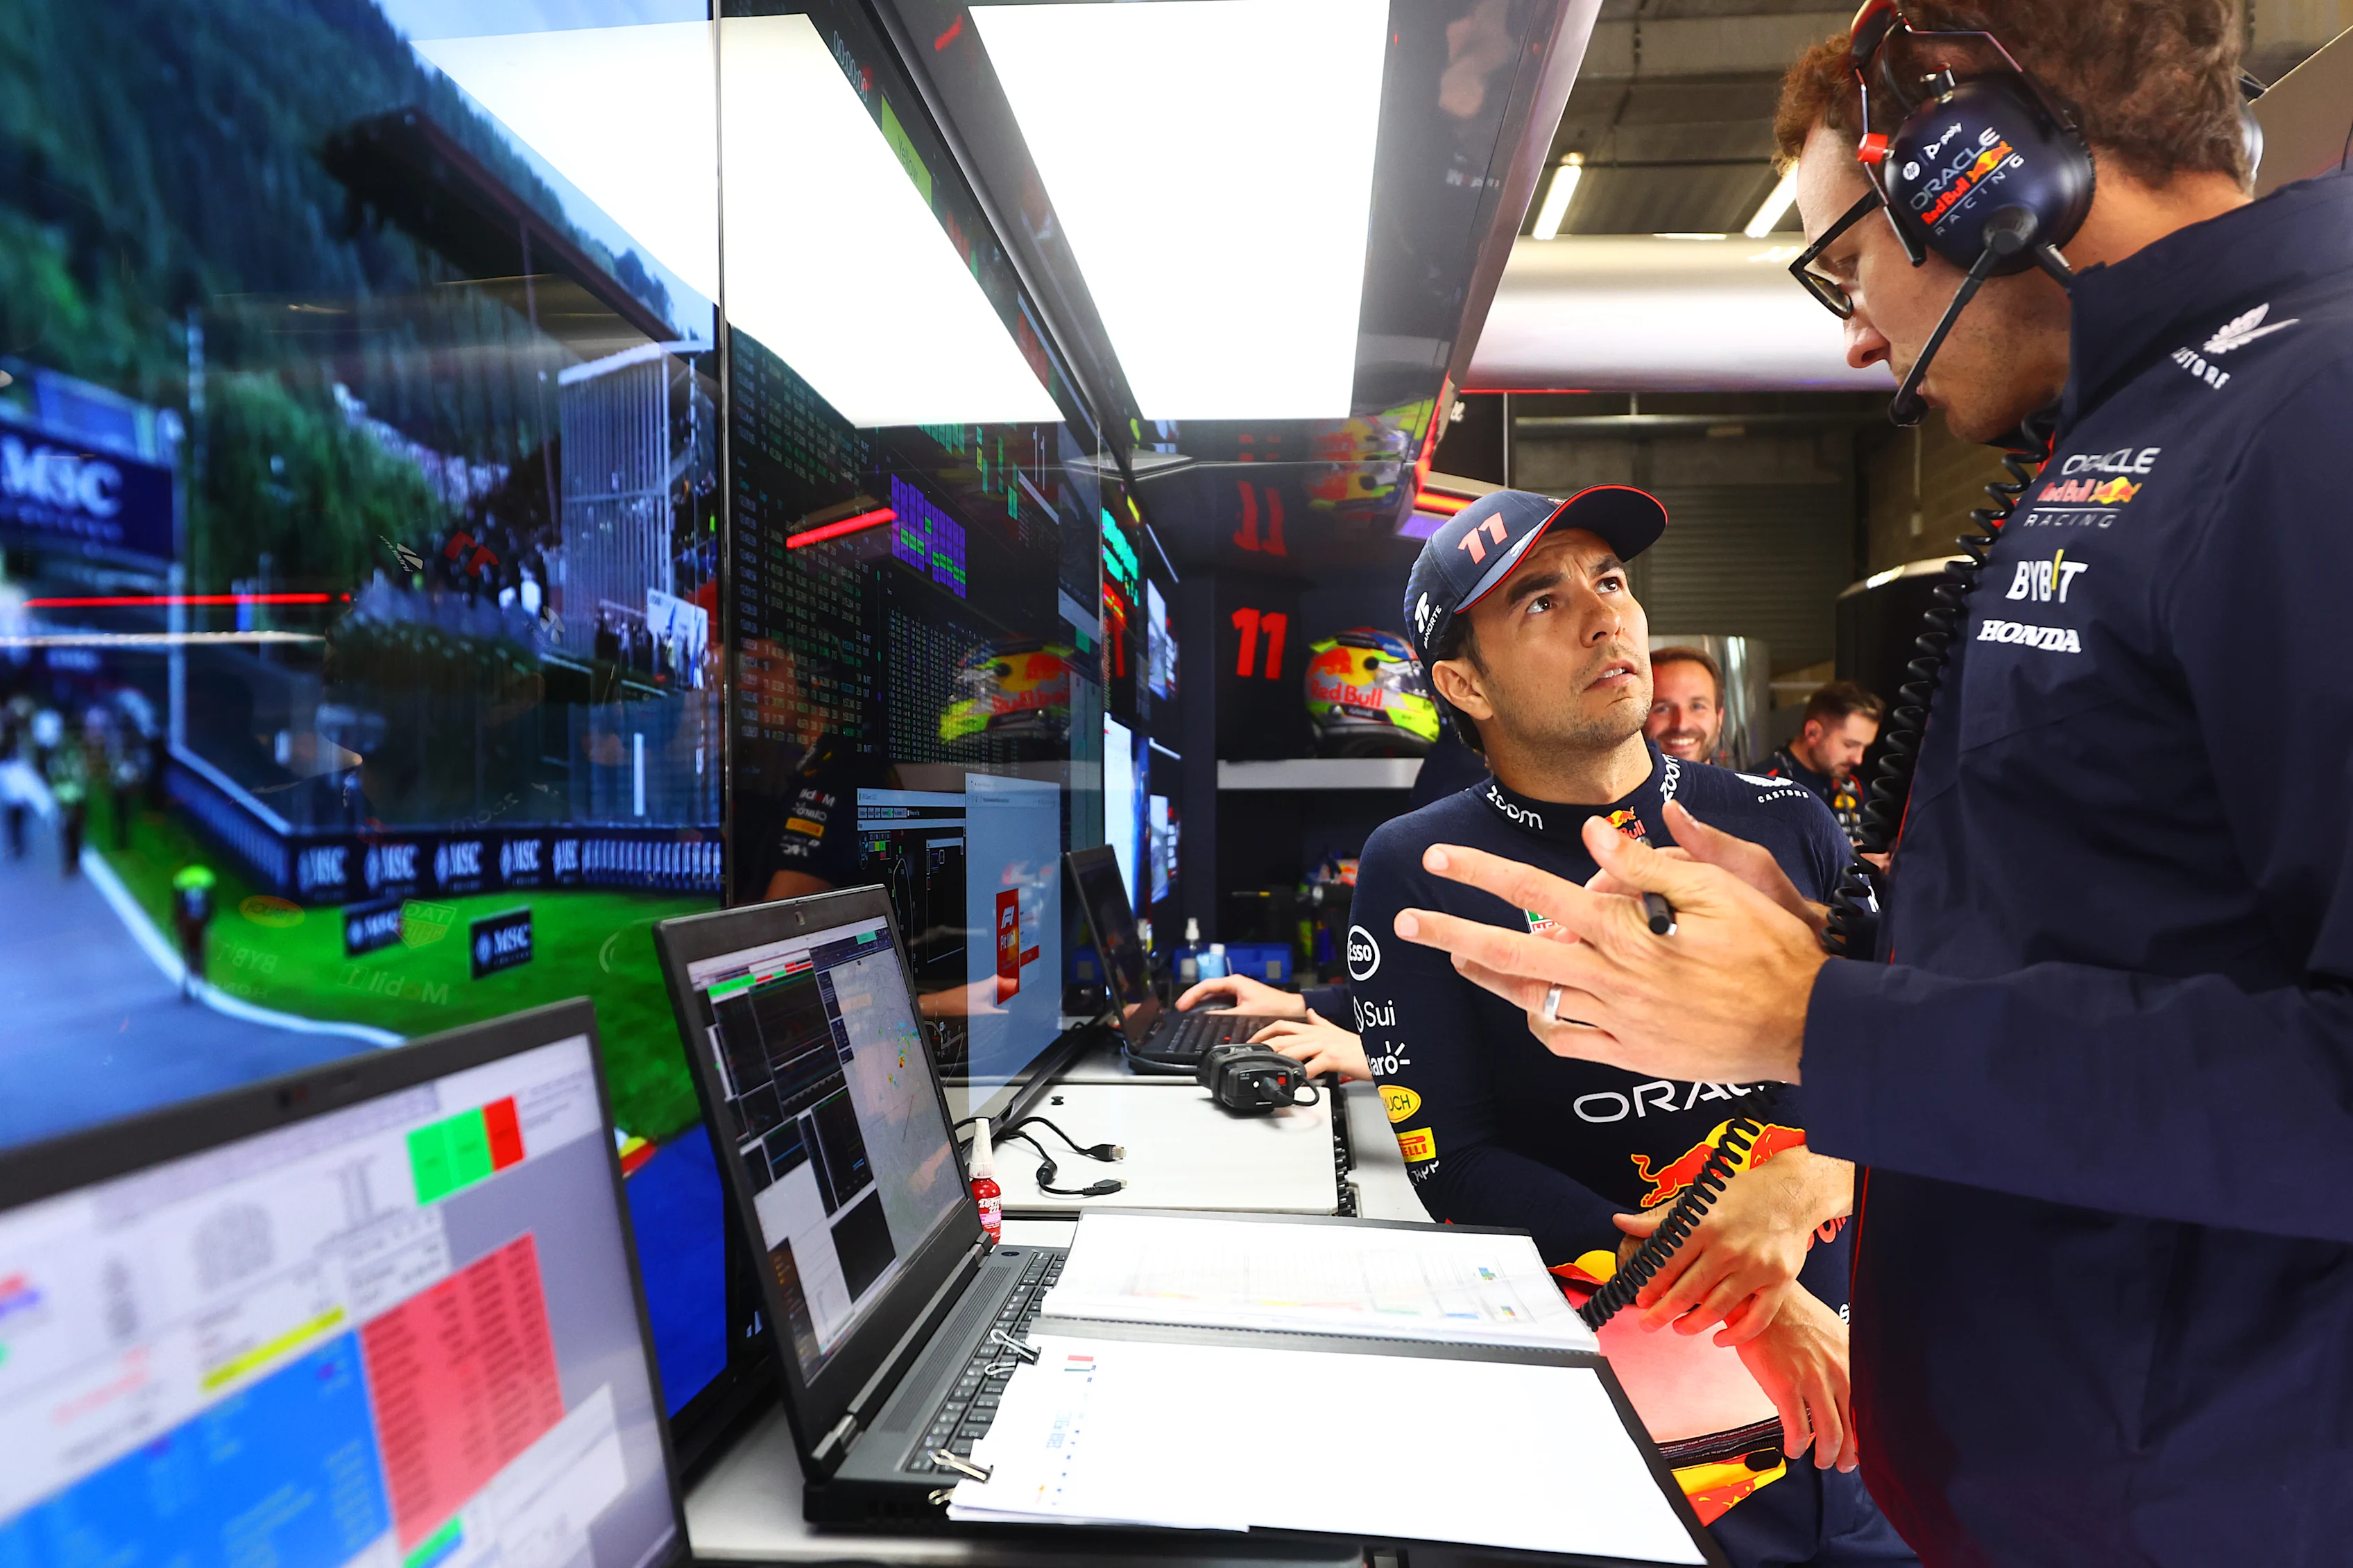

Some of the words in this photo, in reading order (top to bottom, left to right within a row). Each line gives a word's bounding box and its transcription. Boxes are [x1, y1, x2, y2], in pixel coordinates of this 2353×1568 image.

[833, 30, 868, 103] 00:00:00
[898, 134, 918, 184] Yellow
[1910, 126, 2001, 210] ORACLE
[1935, 153, 2025, 236] RACING
[2171, 346, 2231, 390] STORE
[2062, 447, 2162, 476] ORACLE
[2023, 513, 2117, 529] RACING
[2005, 549, 2089, 603] BYBIT
[1232, 607, 1288, 680] 11
[1976, 619, 2082, 653] HONDA
[1310, 678, 1342, 701] Red
[1344, 684, 1383, 707] Bull
[493, 922, 531, 954] MSC
[1364, 999, 1396, 1028] Sui
[1367, 1054, 1399, 1076] laro
[1384, 1094, 1411, 1112] UCH
[1573, 1080, 1755, 1123] ORA
